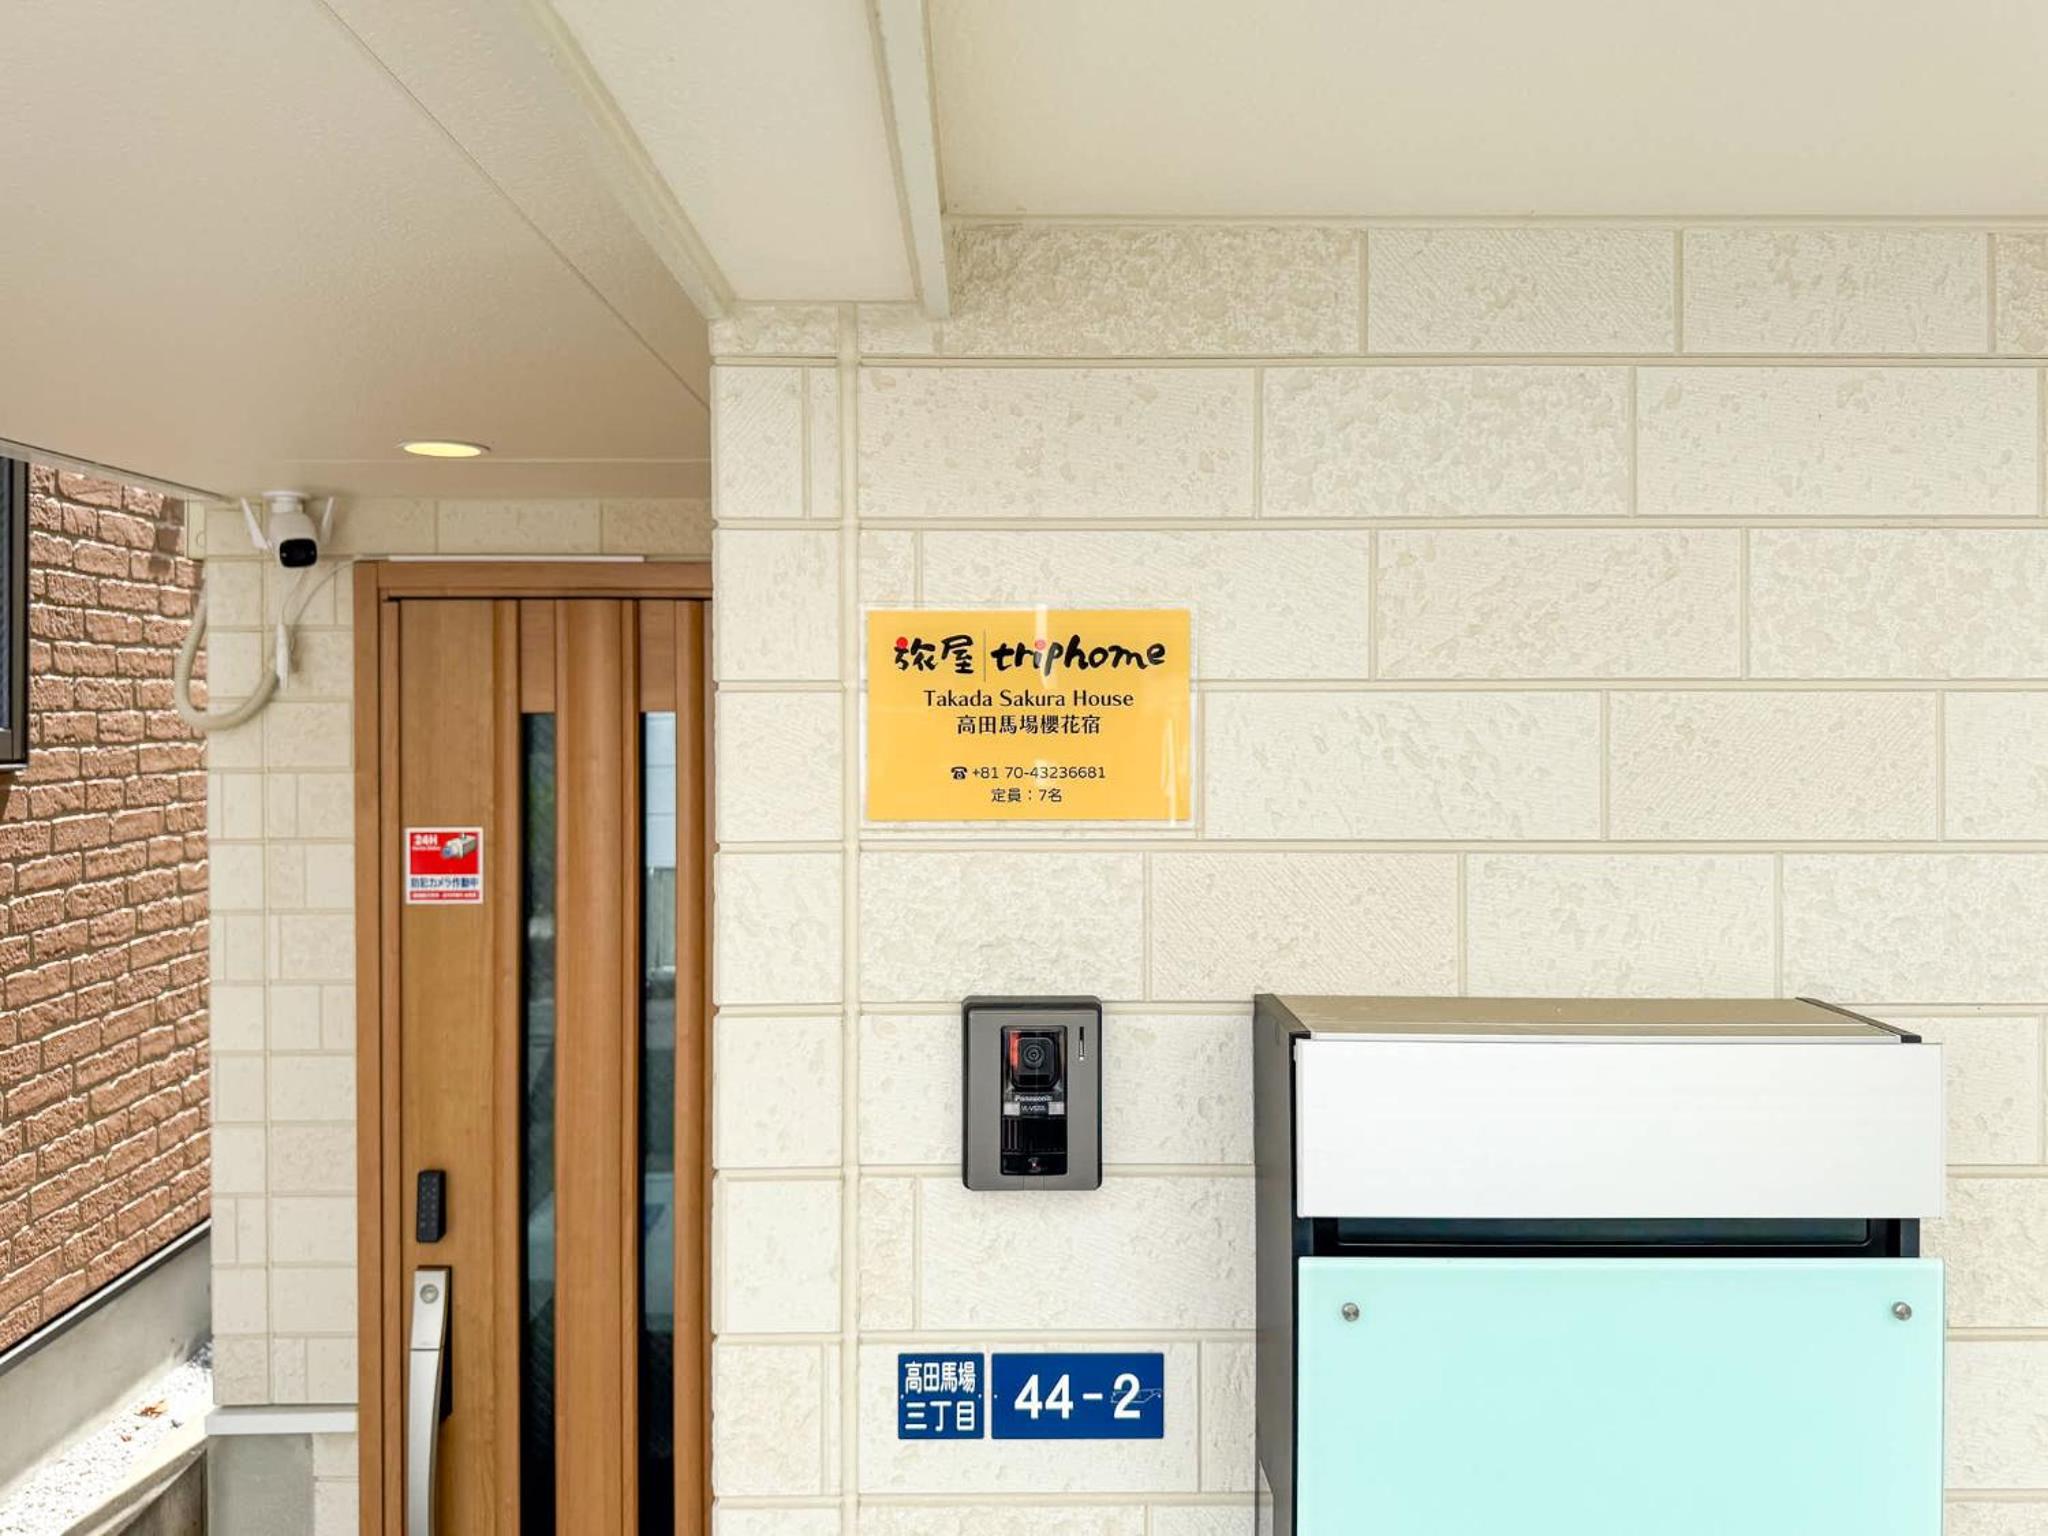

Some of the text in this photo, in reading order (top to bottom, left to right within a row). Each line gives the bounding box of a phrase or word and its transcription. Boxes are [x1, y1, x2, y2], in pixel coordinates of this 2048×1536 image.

[990, 634, 1166, 676] triphome
[923, 690, 1134, 707] Takada Sakura House
[957, 715, 1101, 734] 高田馬場櫻花宿
[972, 766, 1106, 779] +81 70-43236681
[1014, 1094, 1053, 1102] Panasonic
[905, 1361, 976, 1393] 高田馬場
[905, 1401, 976, 1432] 三丁目
